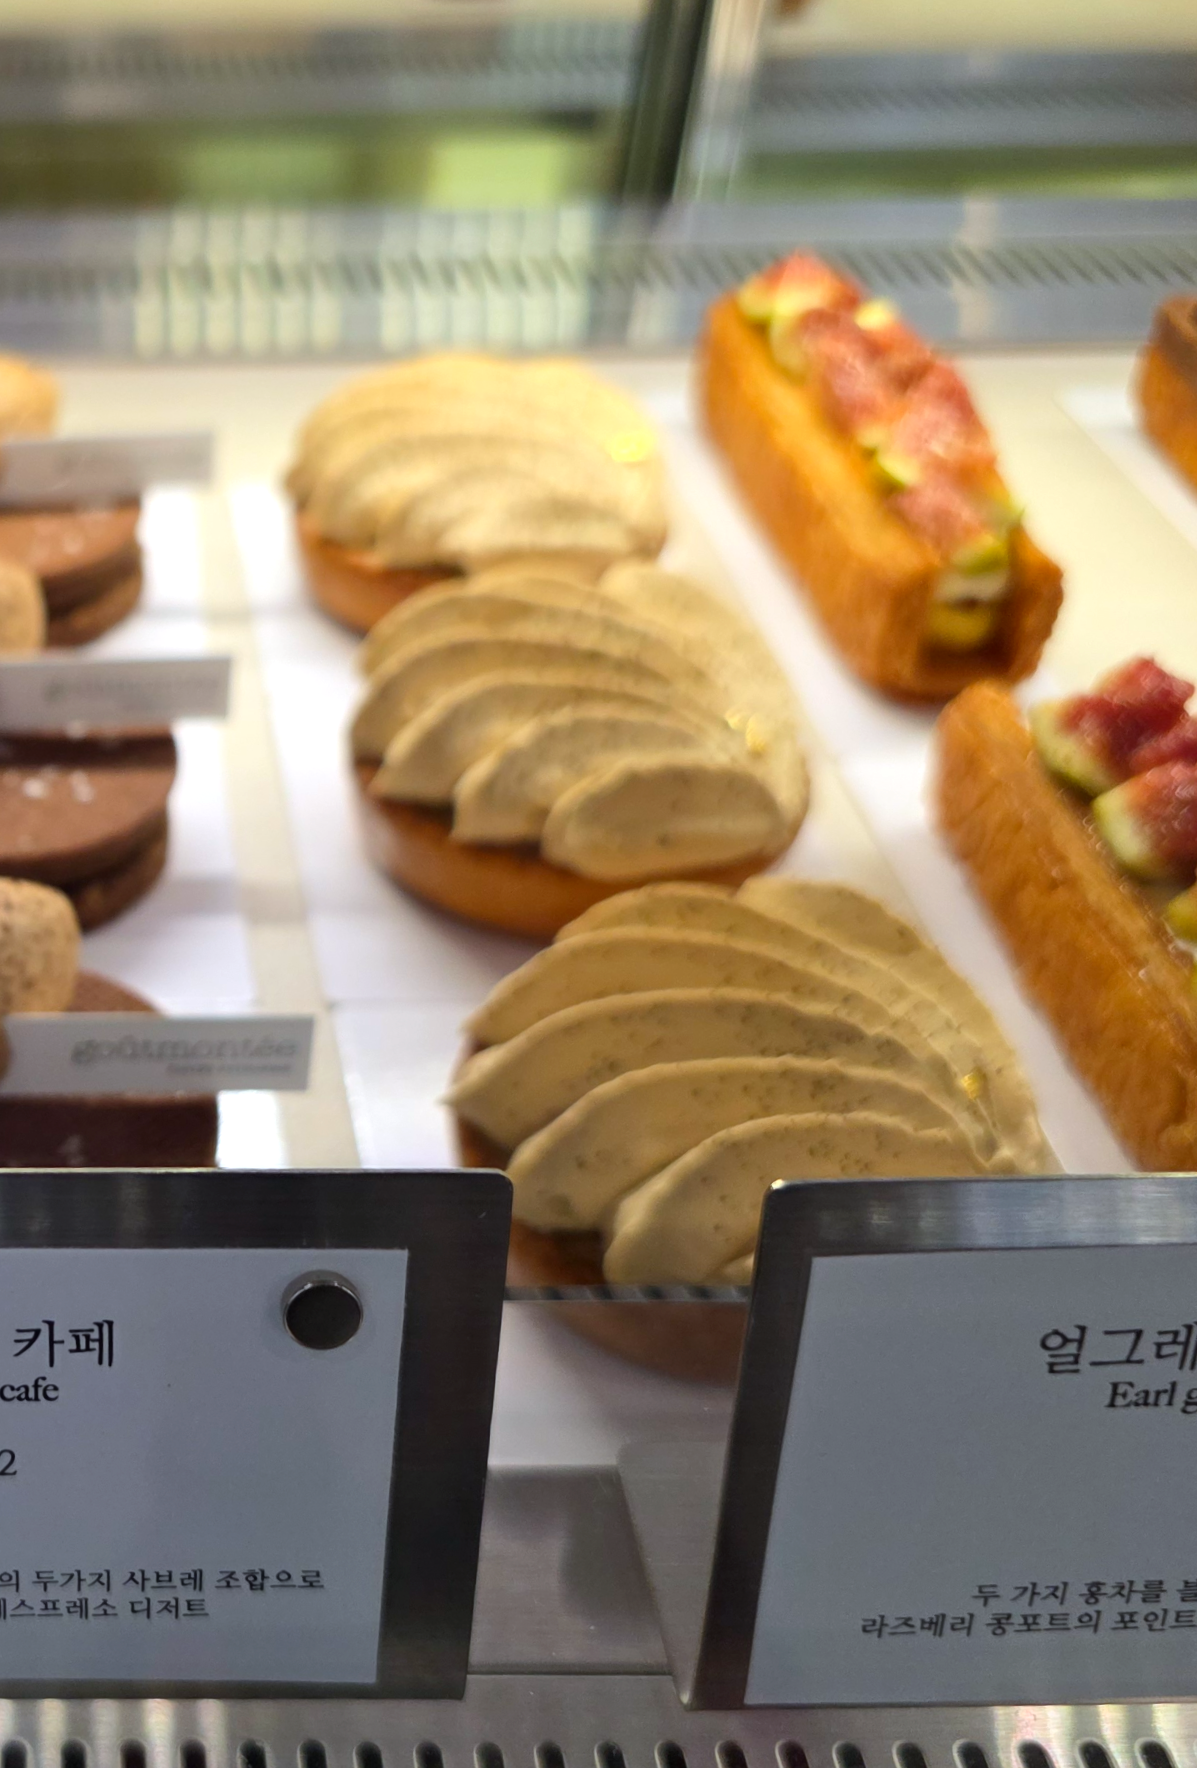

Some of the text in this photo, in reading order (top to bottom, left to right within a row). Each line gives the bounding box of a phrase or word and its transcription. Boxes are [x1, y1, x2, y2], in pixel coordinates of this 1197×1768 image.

[13, 1320, 115, 1368] 카페
[1105, 1380, 1178, 1409] Earl
[31, 1569, 112, 1592] 두가지
[122, 1569, 204, 1592] 사브레
[214, 1568, 325, 1592] 조합으로
[1010, 1581, 1070, 1608] 가지
[1078, 1580, 1168, 1605] 홍차를
[129, 1597, 210, 1620] 디저트
[861, 1607, 1197, 1639] 라즈베리 콩포트의 포인트
